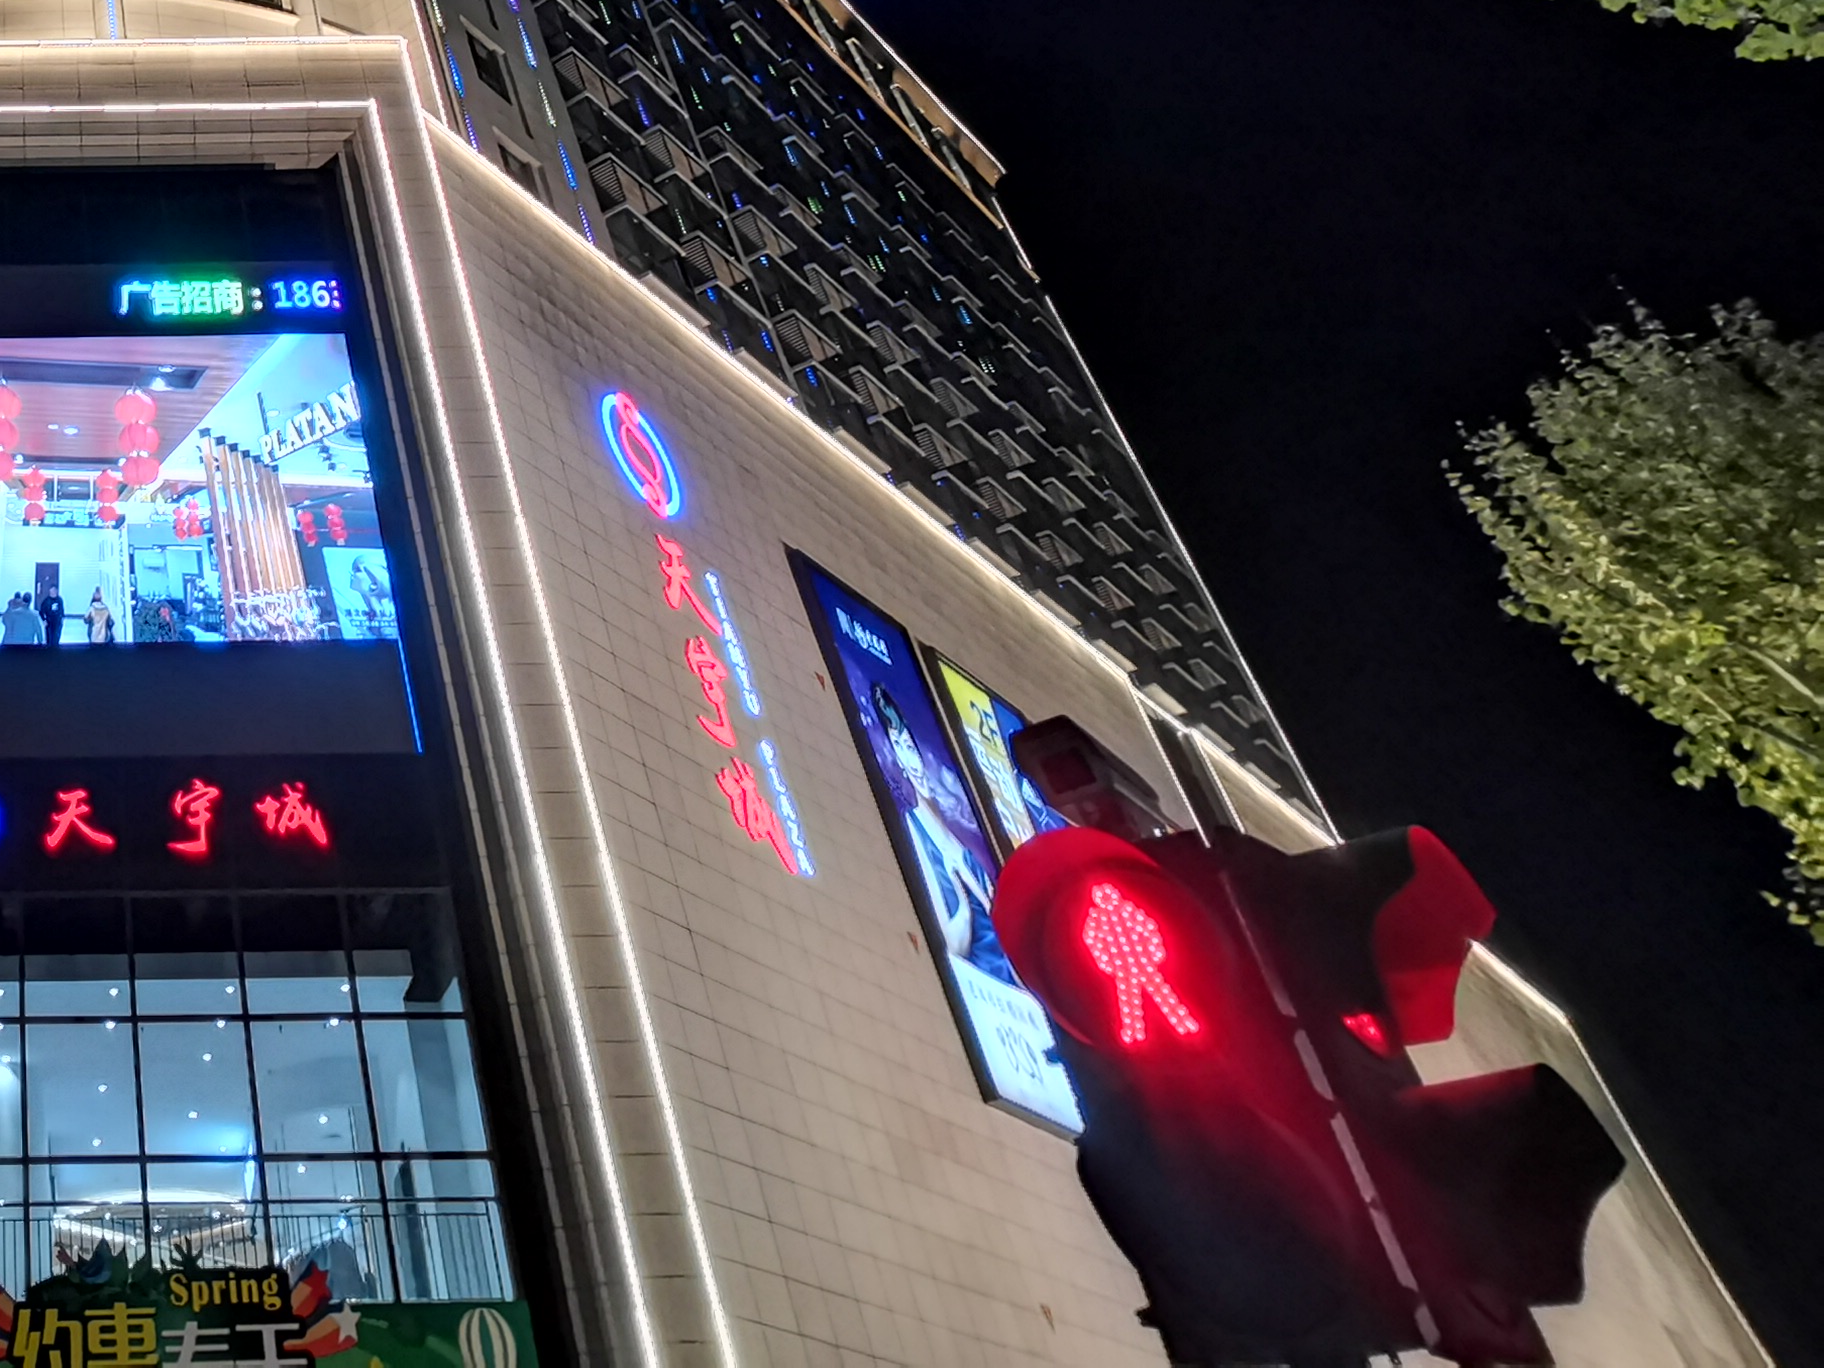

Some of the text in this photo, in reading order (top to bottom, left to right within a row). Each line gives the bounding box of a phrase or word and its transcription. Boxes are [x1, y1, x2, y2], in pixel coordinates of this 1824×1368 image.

[44, 779, 328, 855] 天宇城
[170, 1272, 282, 1311] Spring
